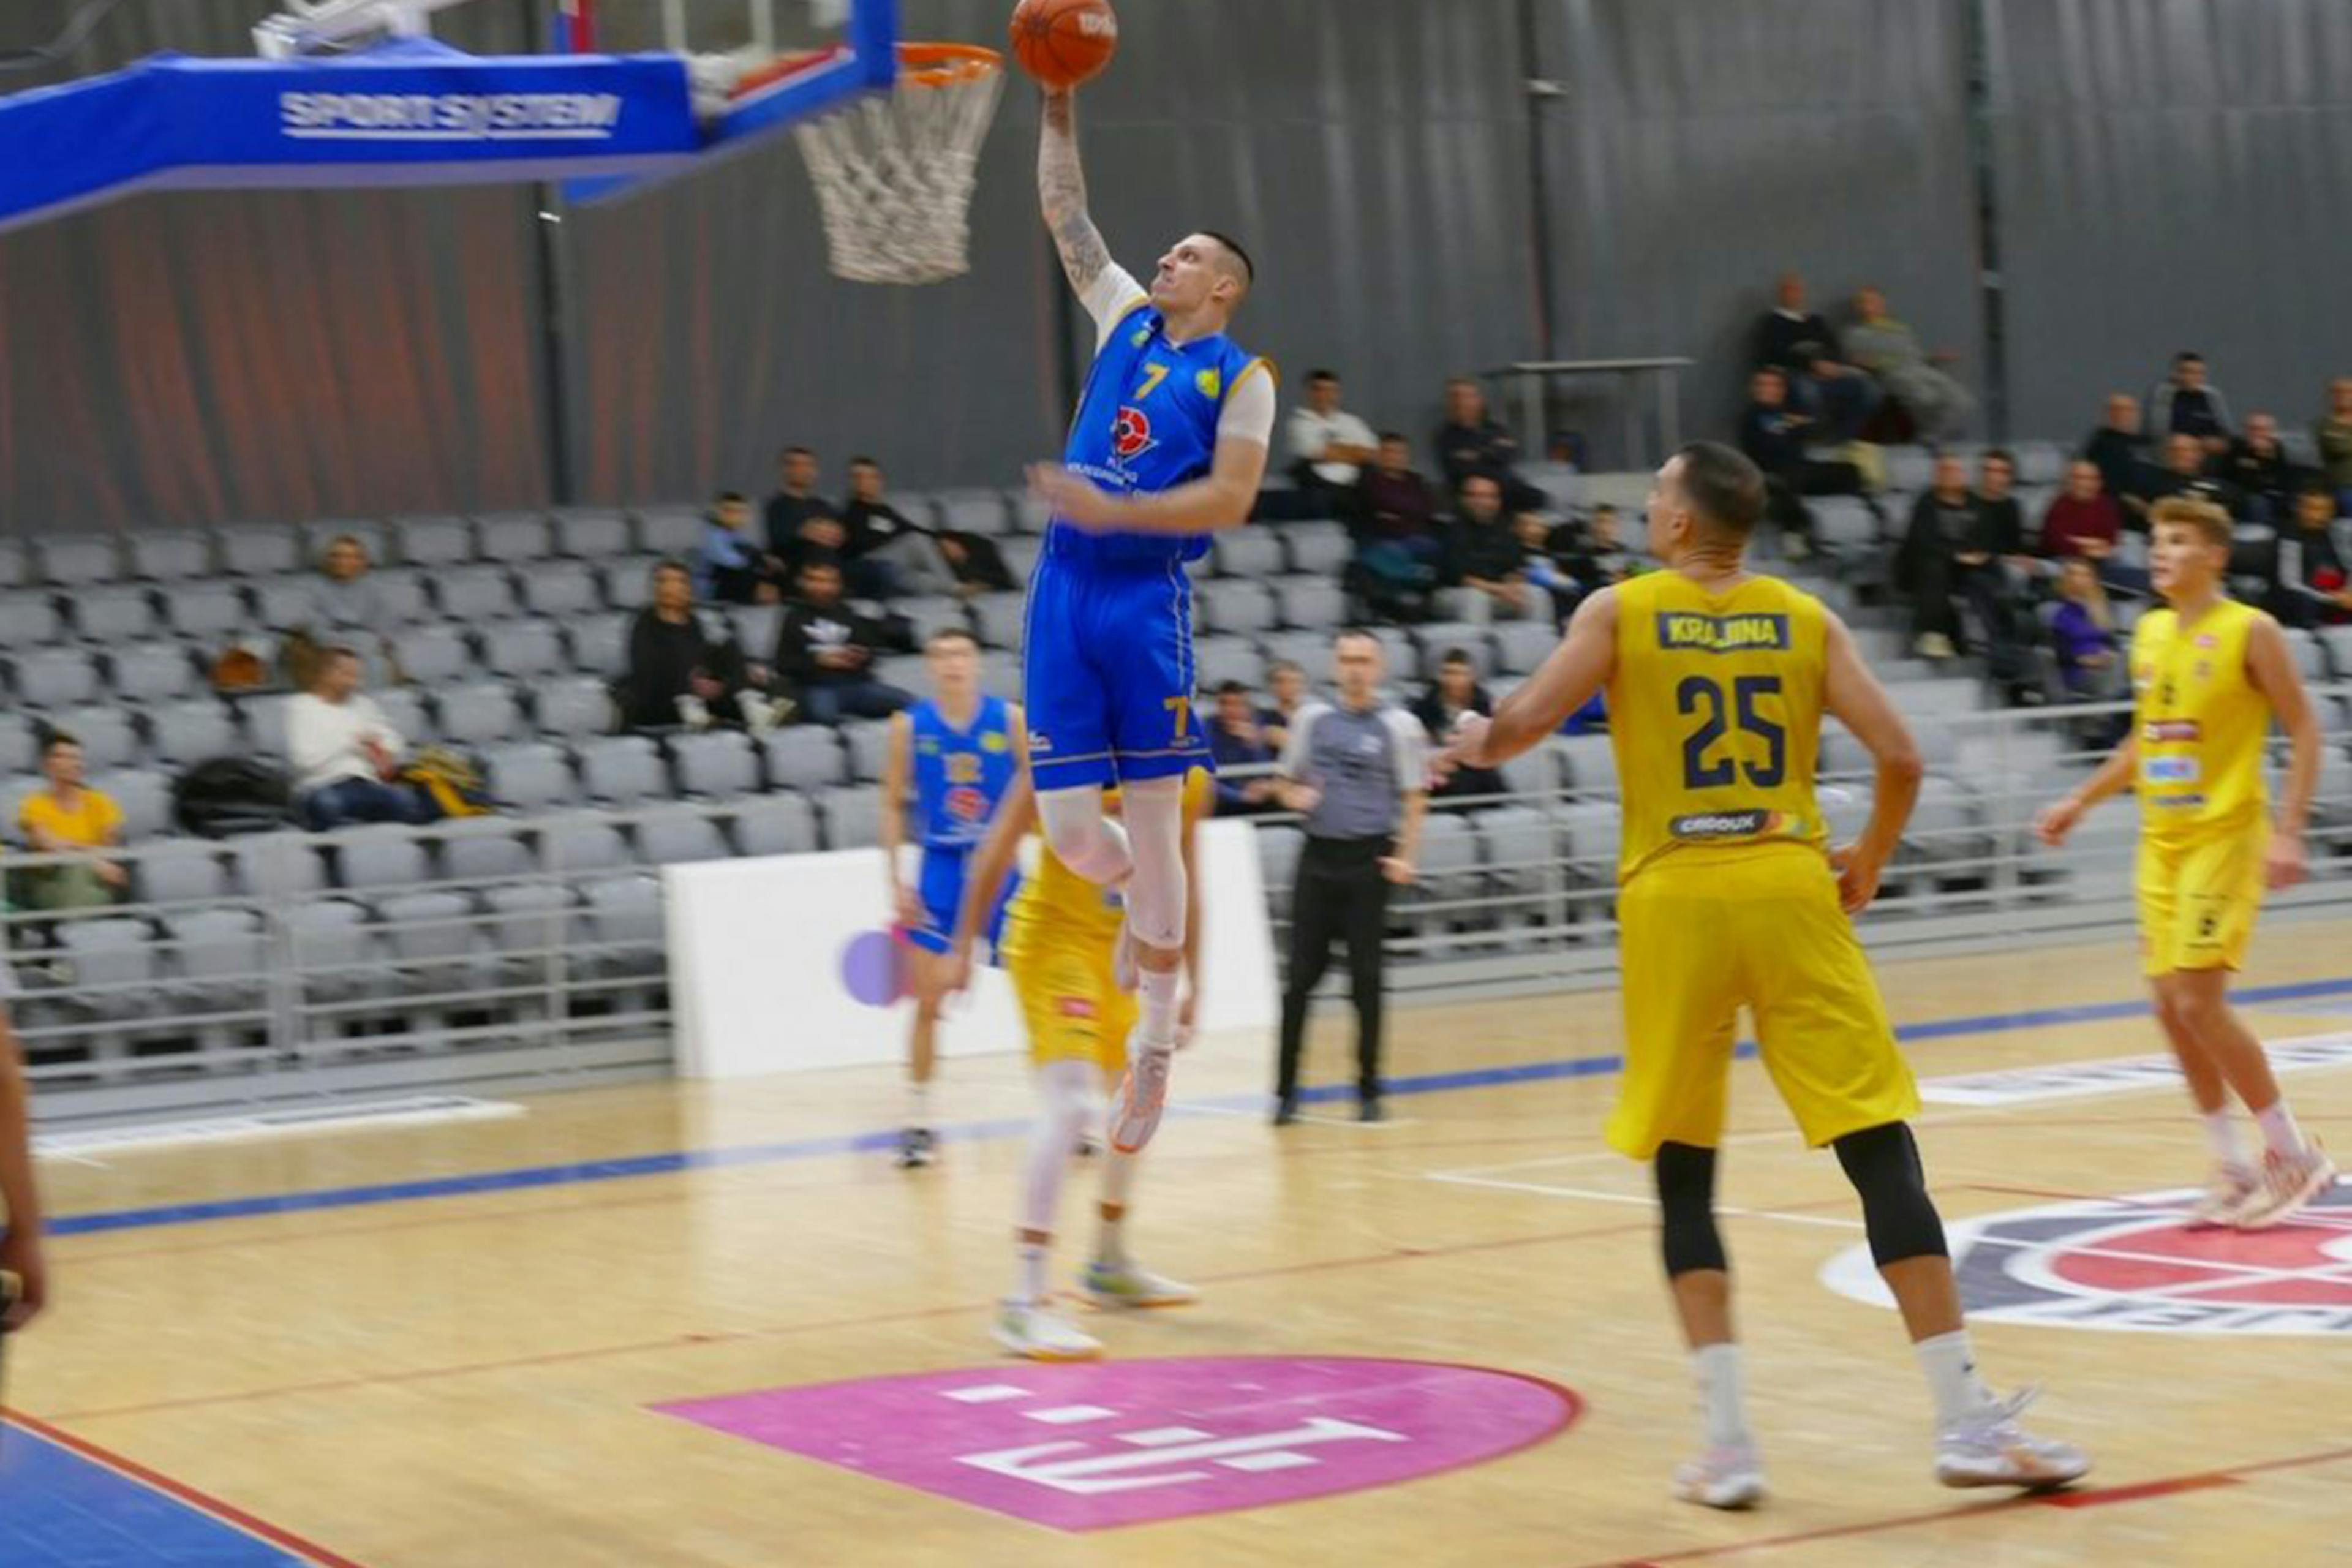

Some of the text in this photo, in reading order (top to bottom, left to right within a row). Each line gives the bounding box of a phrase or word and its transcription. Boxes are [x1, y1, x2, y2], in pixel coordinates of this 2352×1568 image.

[1134, 363, 1170, 399] 7
[1667, 617, 1779, 647] KRAJINA
[1164, 696, 1189, 739] 7
[1676, 675, 1787, 789] 25
